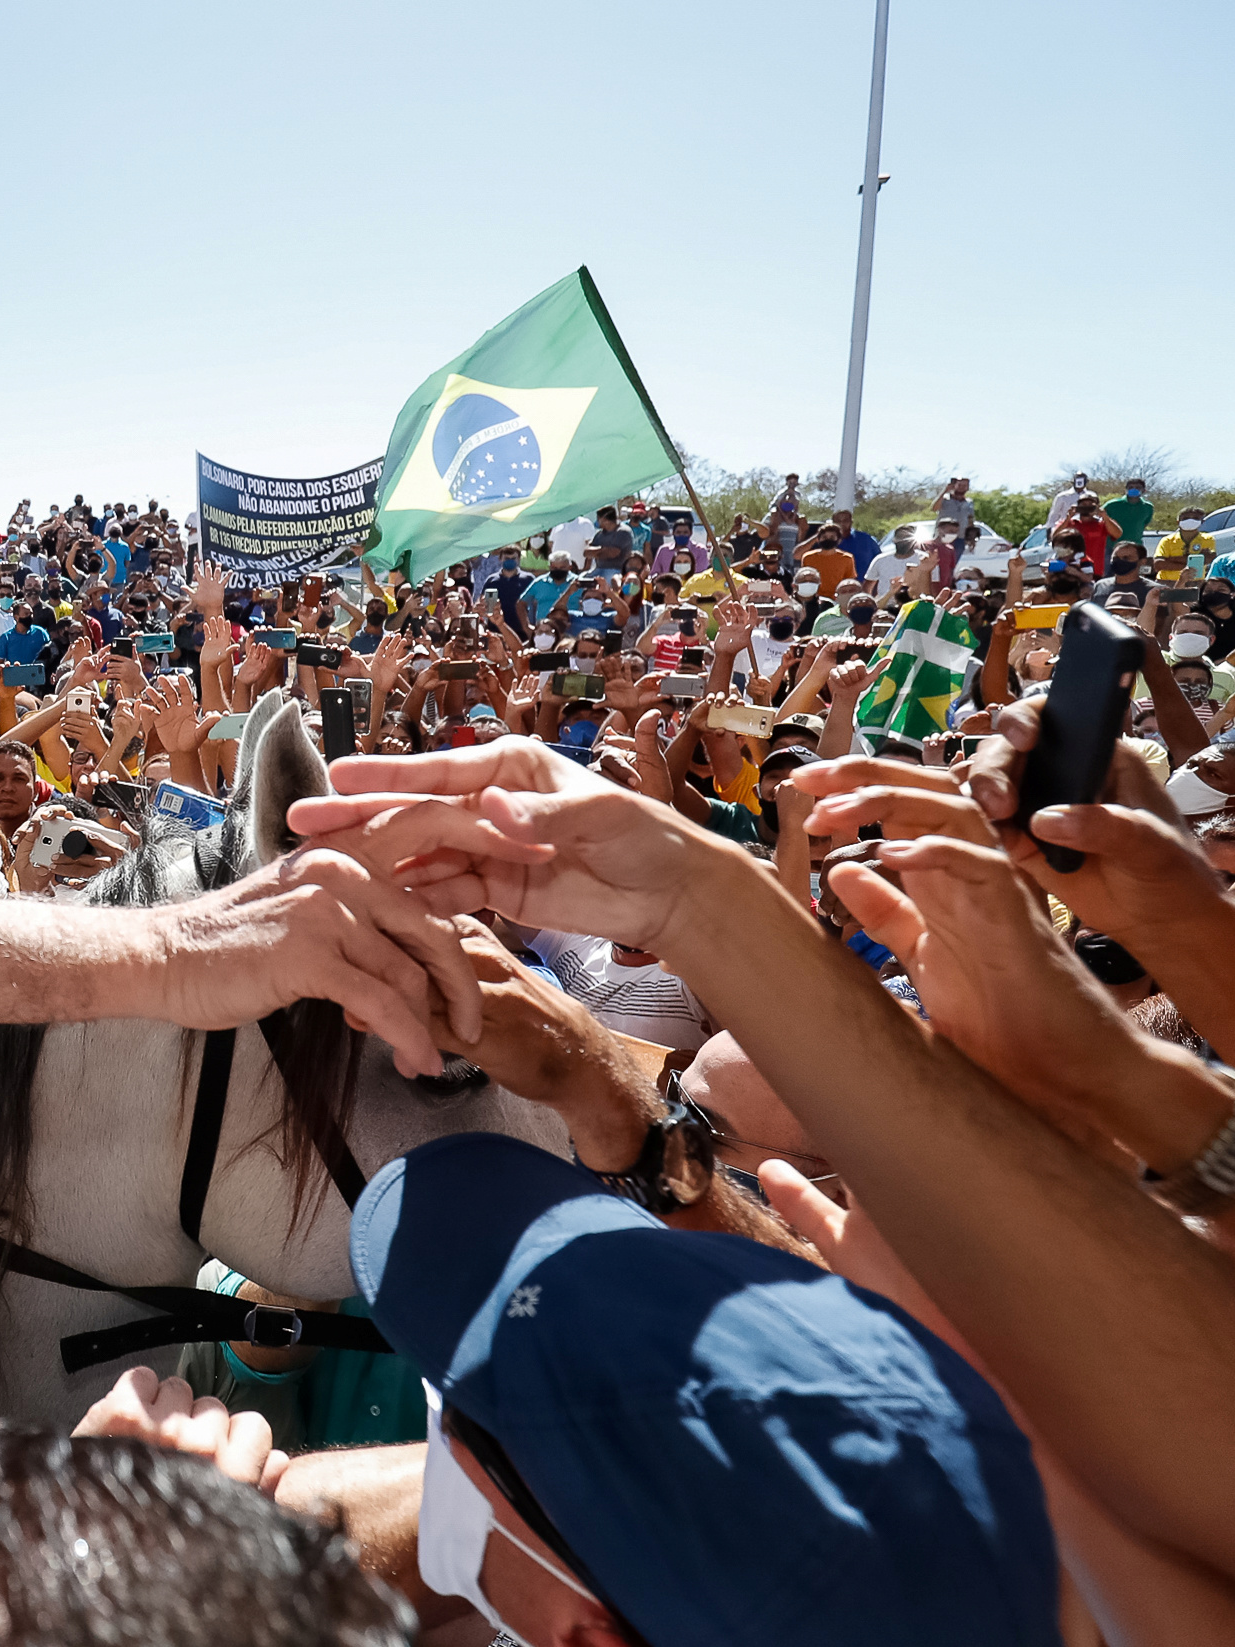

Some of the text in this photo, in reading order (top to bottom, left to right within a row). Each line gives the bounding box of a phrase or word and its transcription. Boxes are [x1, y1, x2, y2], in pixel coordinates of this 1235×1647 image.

[202, 460, 247, 495] BOLSONARO,
[248, 477, 267, 496] POR
[268, 481, 305, 498] CAUSA
[306, 480, 331, 497] DOS
[238, 486, 365, 515] NÃO ABANDONE O PIAUÍ
[202, 503, 236, 530] CLAMAMOS
[237, 515, 256, 534] PELA
[257, 515, 345, 536] REFEDERALIZAÇÃO
[346, 514, 354, 529] E
[209, 526, 219, 544] BR
[219, 531, 231, 548] 135
[231, 534, 262, 555] TRECHO
